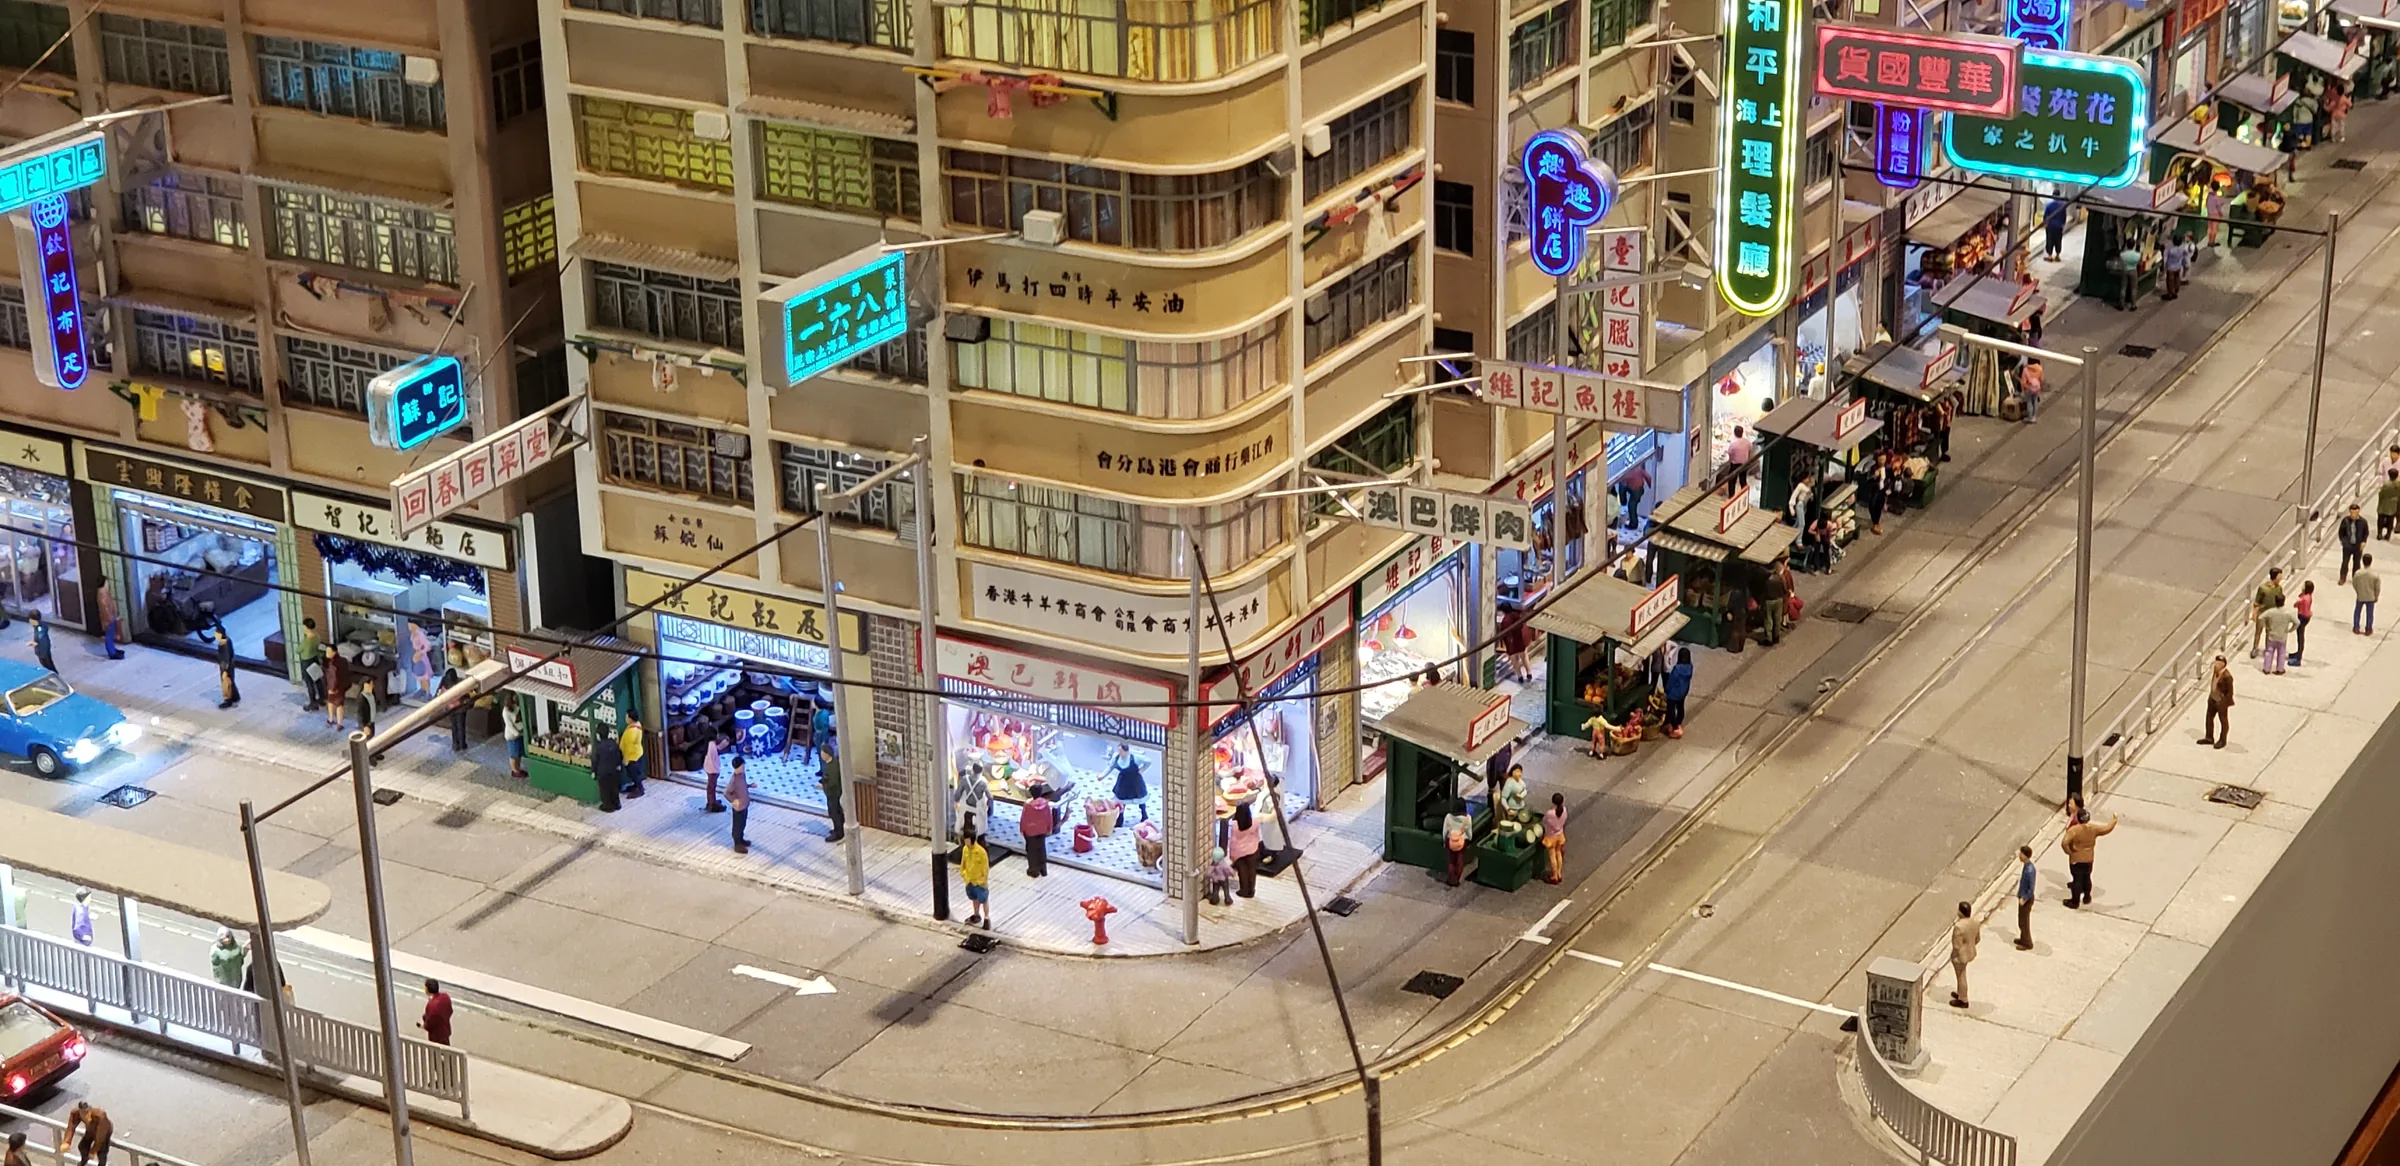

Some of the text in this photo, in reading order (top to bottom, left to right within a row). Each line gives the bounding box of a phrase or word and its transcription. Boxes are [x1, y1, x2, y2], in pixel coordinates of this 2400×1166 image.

[402, 427, 547, 523] 回春百草堂
[324, 503, 476, 557] 智記麵店
[1367, 489, 1526, 543] 澳巴鮮肉
[1385, 536, 1462, 594] 維記魚
[985, 584, 1107, 623] 香港牛羊業商會
[967, 651, 1123, 702] 澳巴鮮肉
